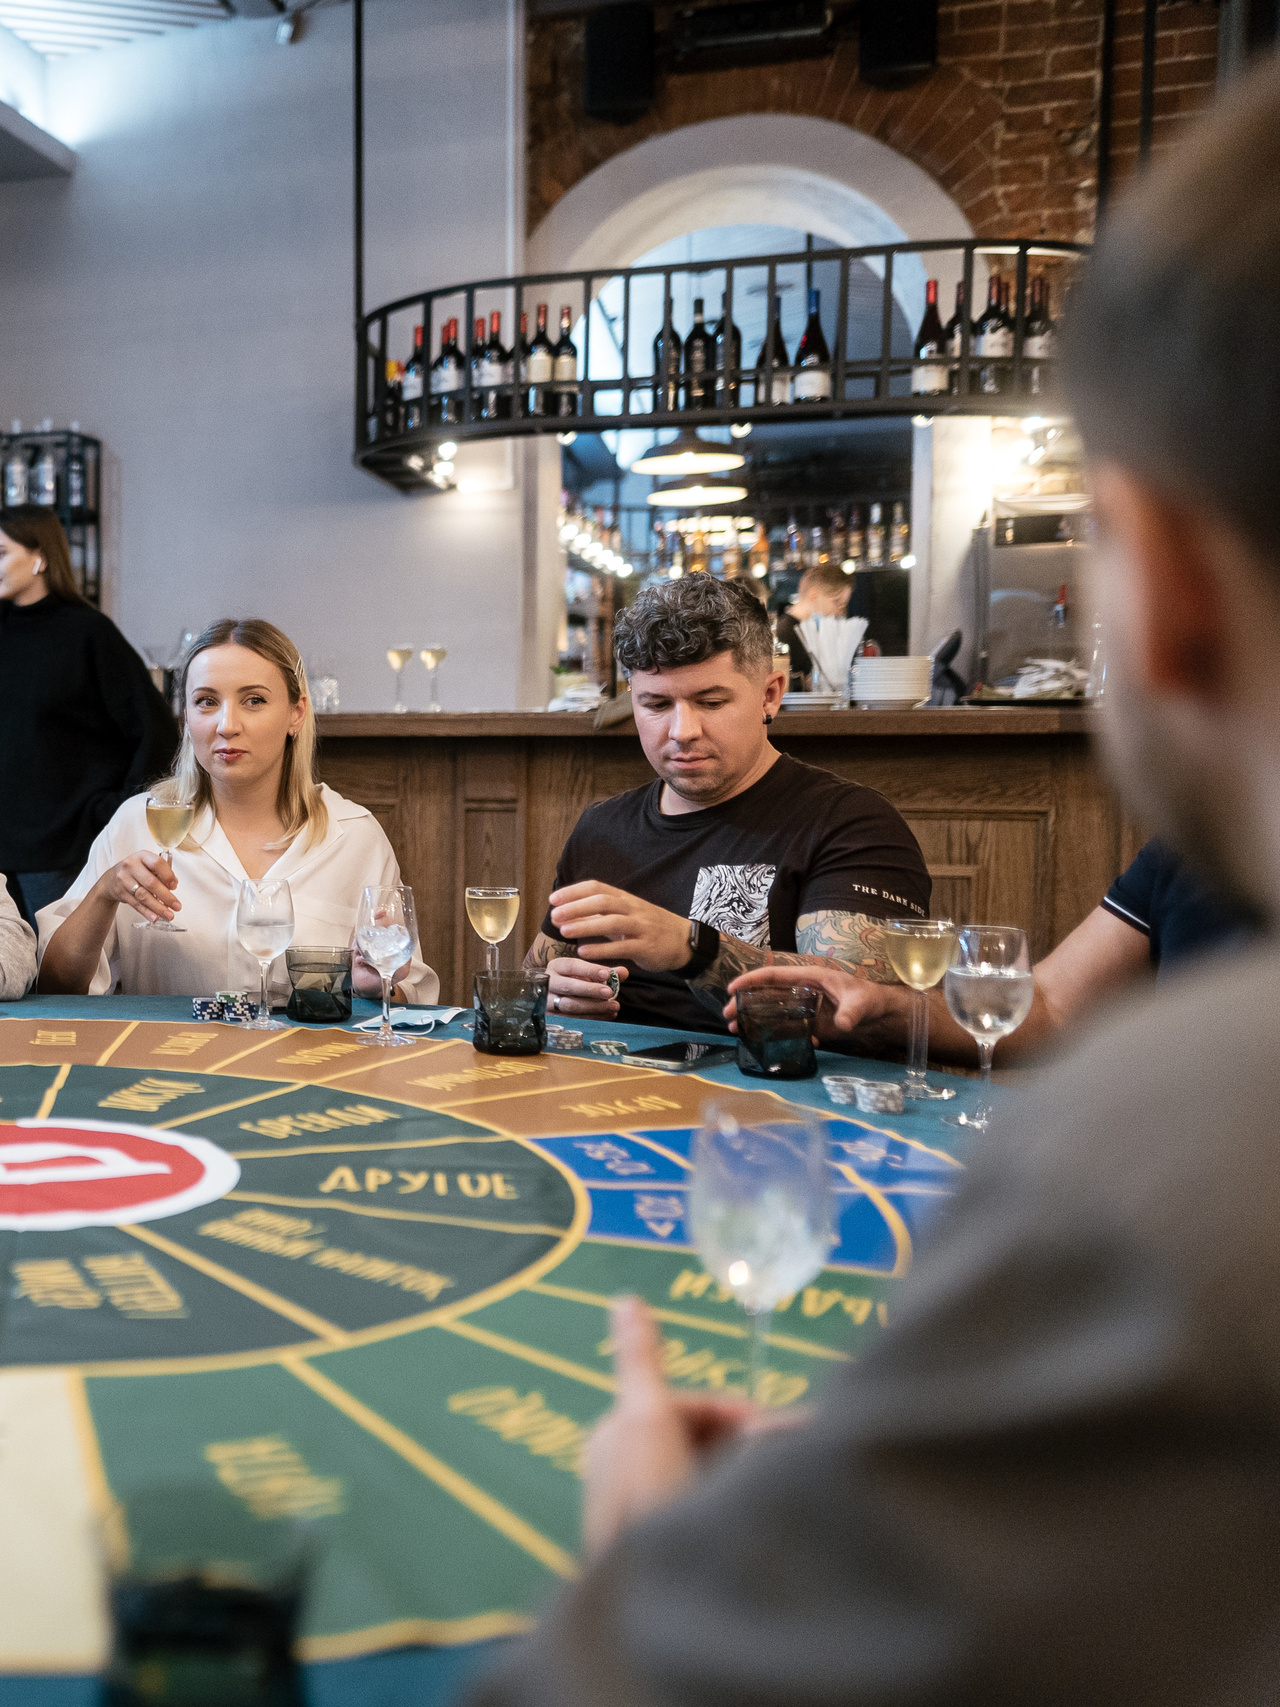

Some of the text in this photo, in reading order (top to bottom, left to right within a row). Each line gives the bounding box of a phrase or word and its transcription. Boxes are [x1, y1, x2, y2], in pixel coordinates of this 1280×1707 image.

[852, 884, 878, 895] THE
[882, 890, 908, 906] DARK
[98, 1077, 207, 1112] ВИСКИ
[240, 1103, 400, 1140] БРЕНДИ
[320, 1166, 520, 1200] ДРУГОЕ
